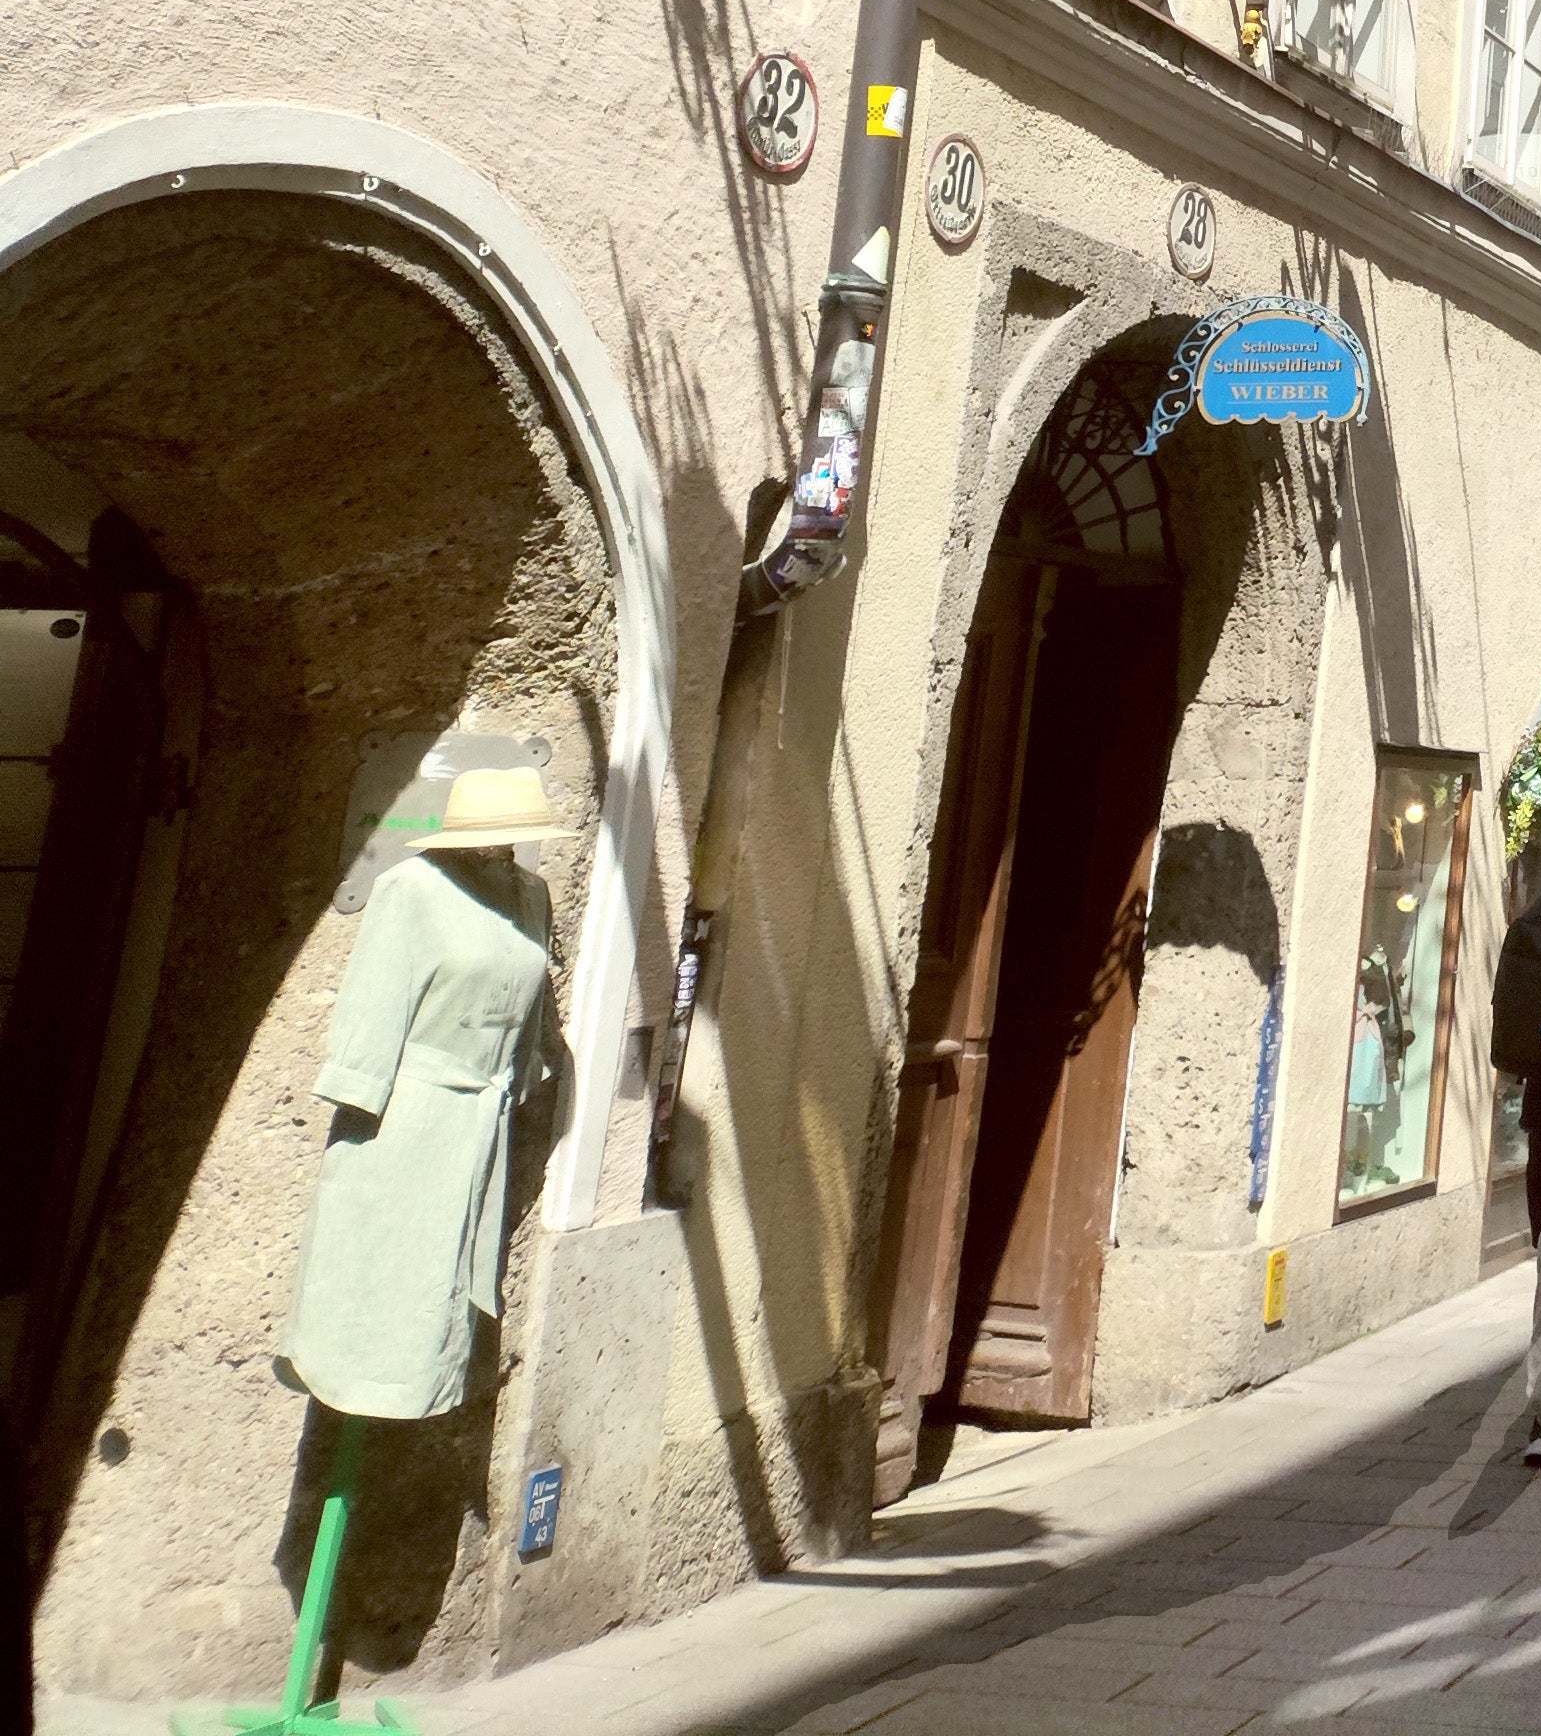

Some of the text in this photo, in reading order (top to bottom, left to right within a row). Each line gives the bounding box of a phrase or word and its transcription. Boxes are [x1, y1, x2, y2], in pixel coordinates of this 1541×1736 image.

[756, 59, 806, 139] 32
[940, 144, 975, 213] 30
[1179, 191, 1208, 250] 28
[1241, 340, 1319, 353] Schlosserei
[1212, 358, 1343, 375] Schlüsseldienst
[1230, 384, 1328, 401] WIEBER
